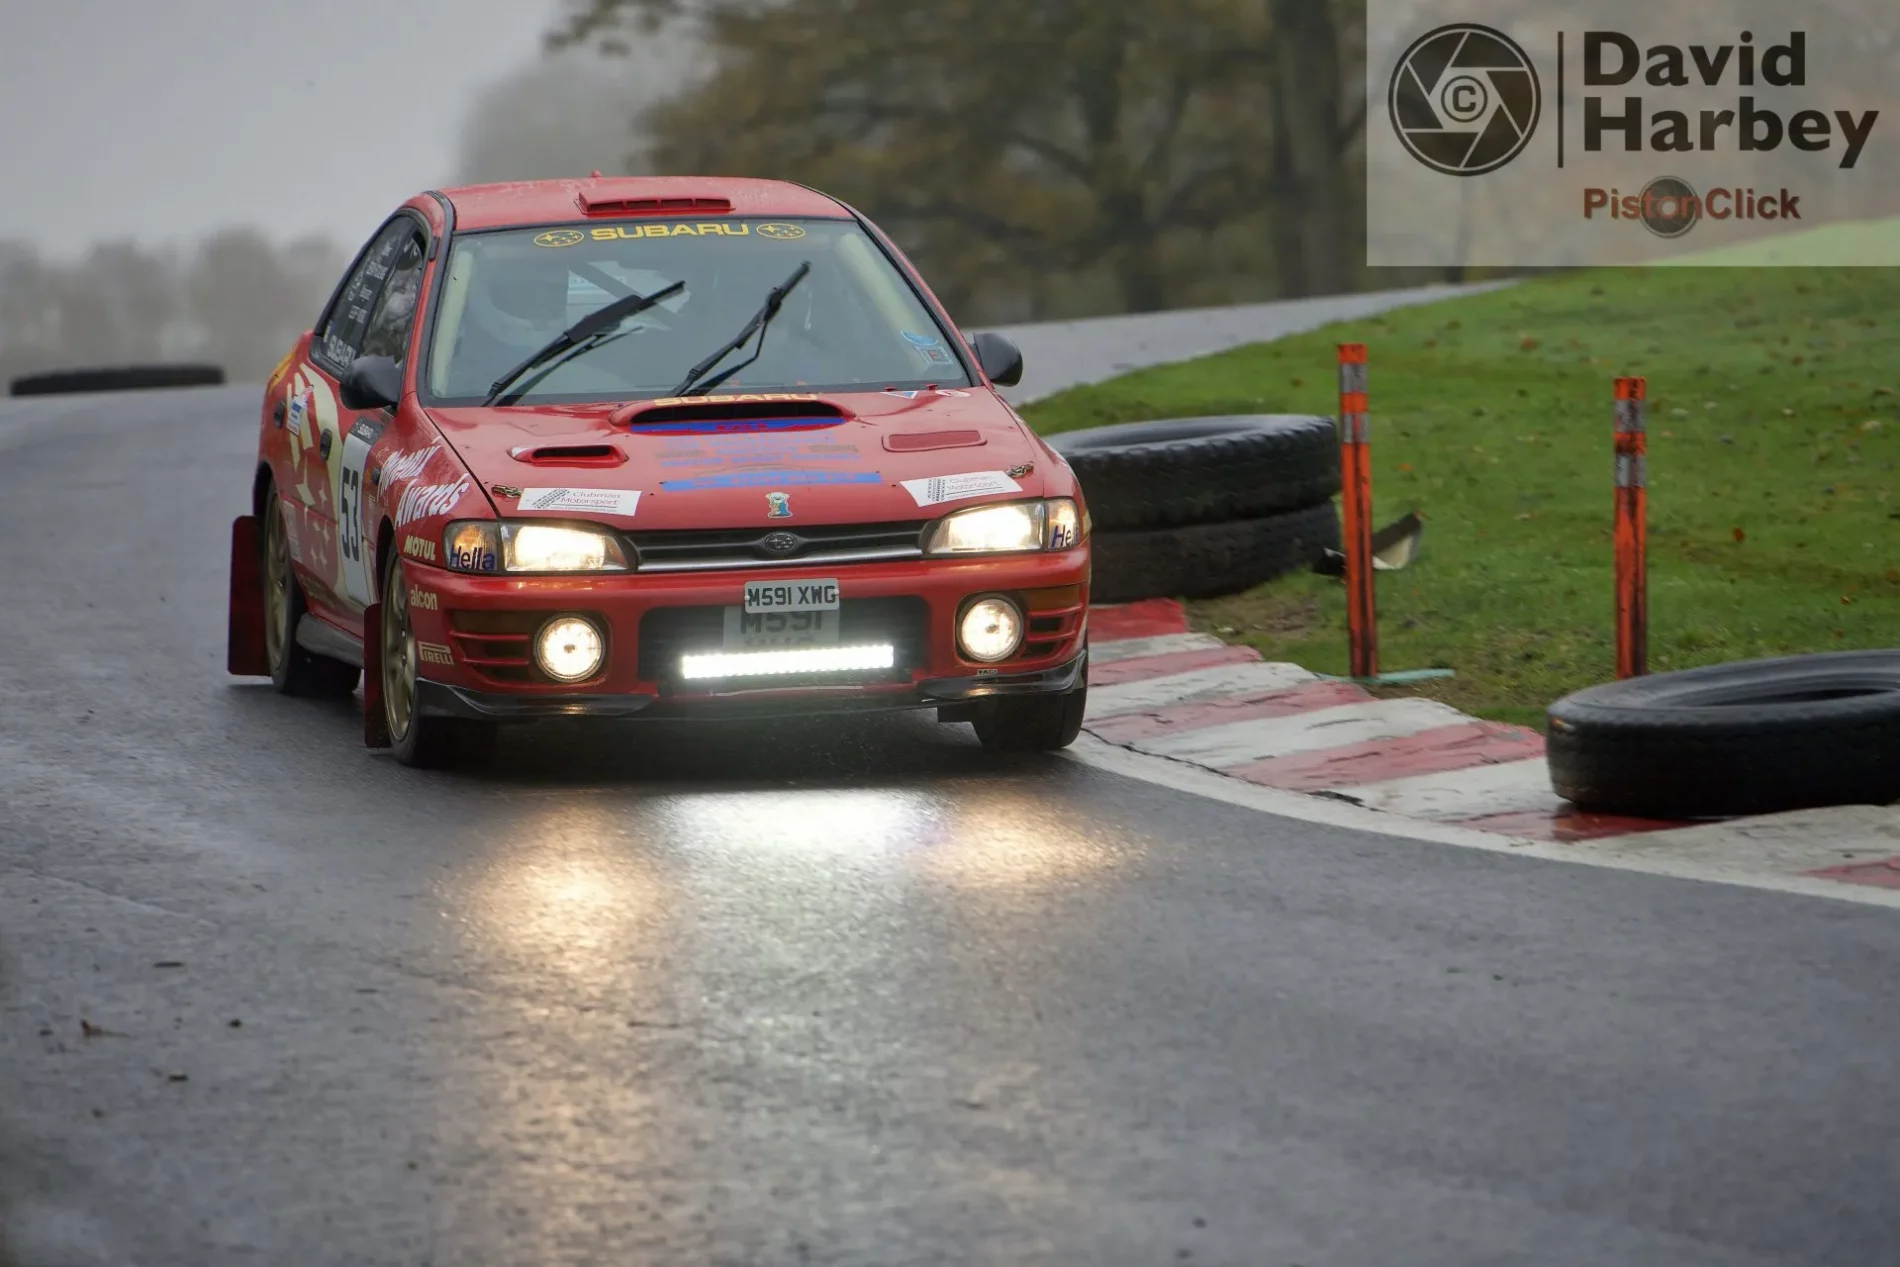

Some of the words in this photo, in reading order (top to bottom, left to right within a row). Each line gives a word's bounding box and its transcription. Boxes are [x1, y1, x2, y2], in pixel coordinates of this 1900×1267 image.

[591, 223, 749, 241] SUBARU
[654, 393, 817, 406] SUBARU
[341, 467, 359, 562] 53
[404, 535, 436, 560] MOTUL
[450, 545, 496, 571] Hella
[410, 584, 438, 610] alcon
[748, 586, 792, 606] M591
[797, 585, 836, 604] XWG
[418, 641, 455, 665] PIRELLI
